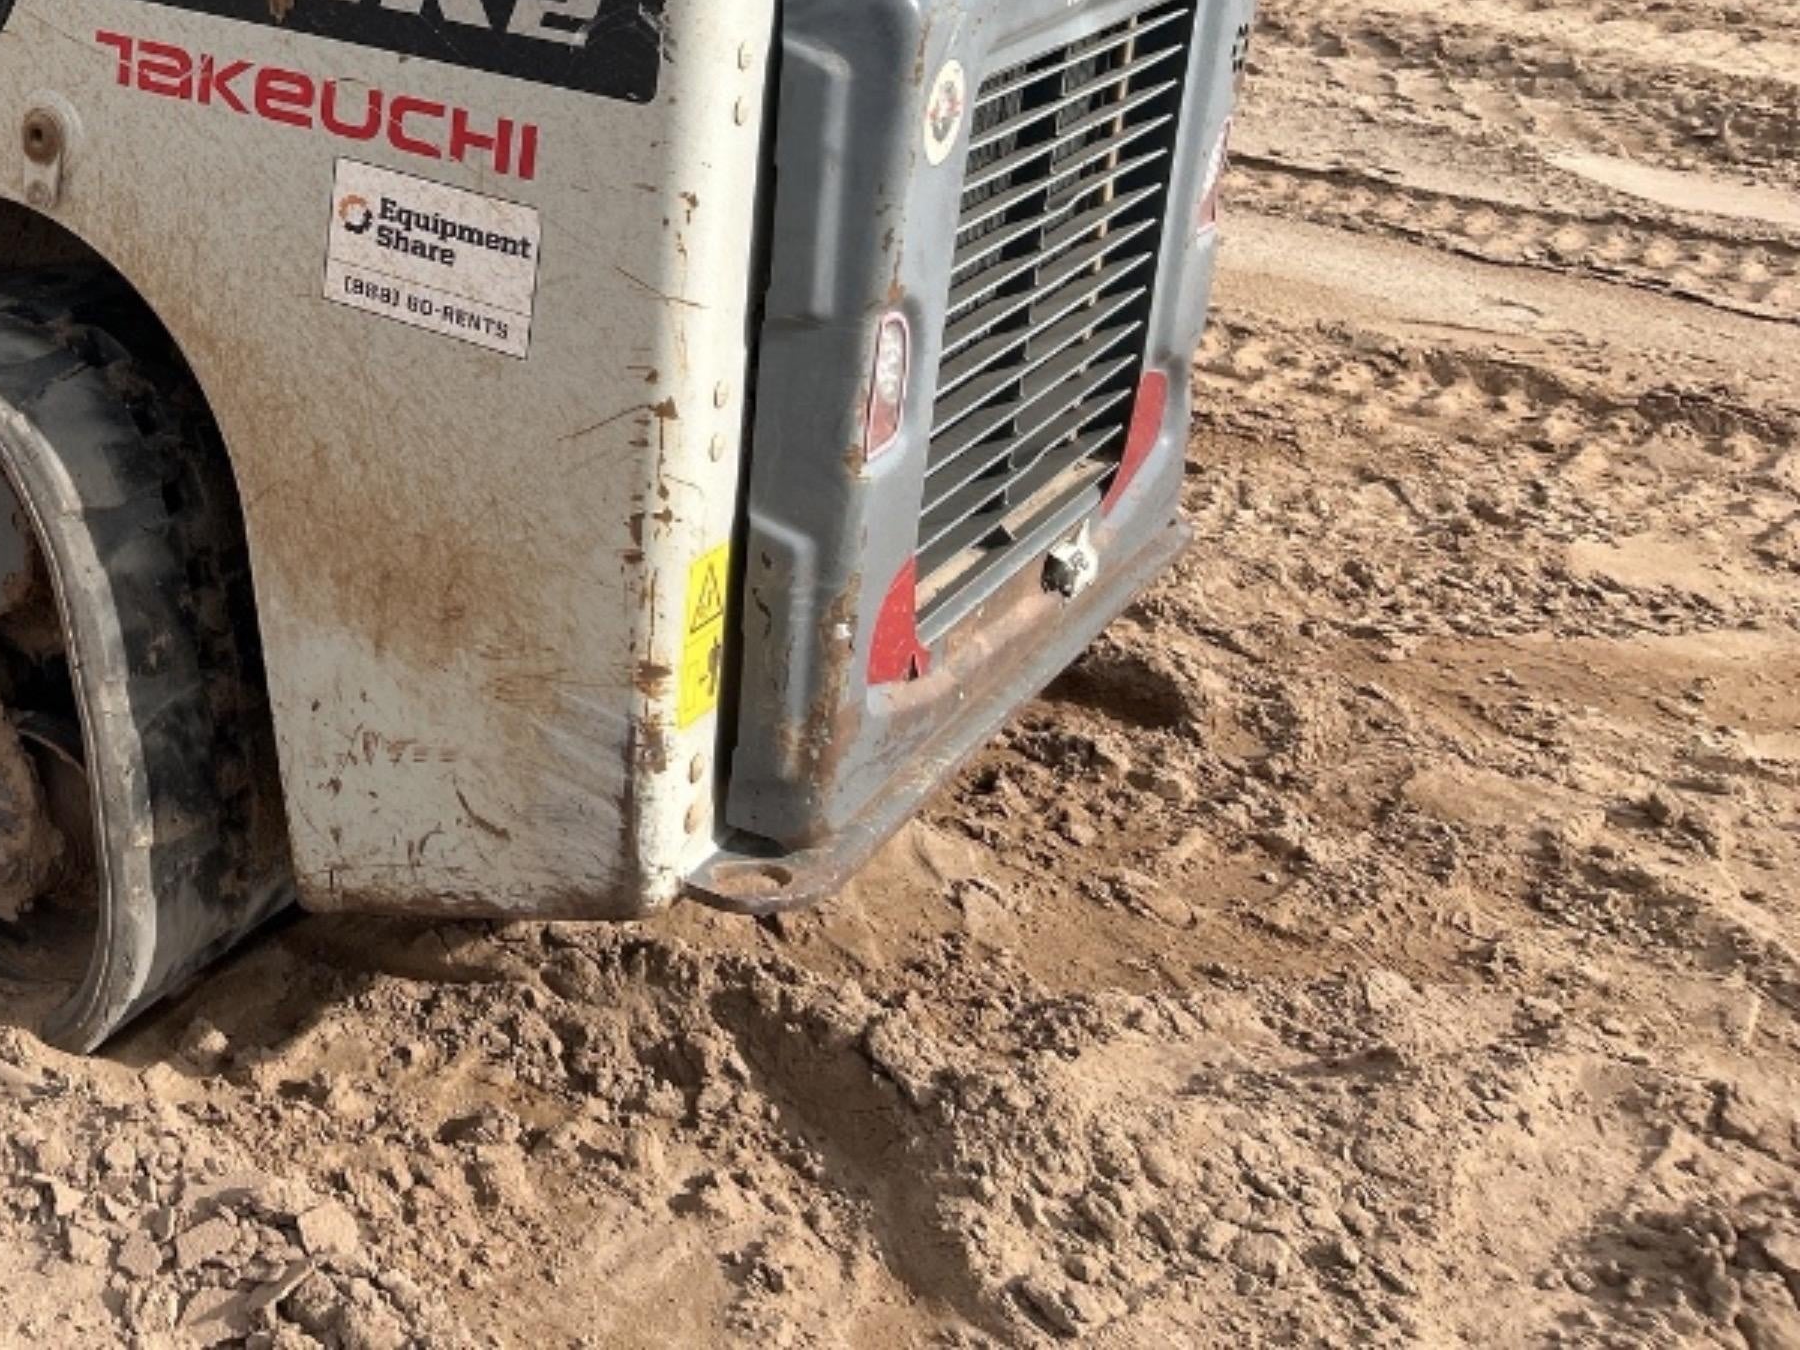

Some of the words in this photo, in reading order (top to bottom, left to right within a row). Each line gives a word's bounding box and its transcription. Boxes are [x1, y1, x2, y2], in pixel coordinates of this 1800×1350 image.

[375, 224, 456, 267] Share
[377, 197, 533, 259] Equipment
[344, 275, 400, 307] (888)
[406, 294, 509, 340] 80-RENTS
